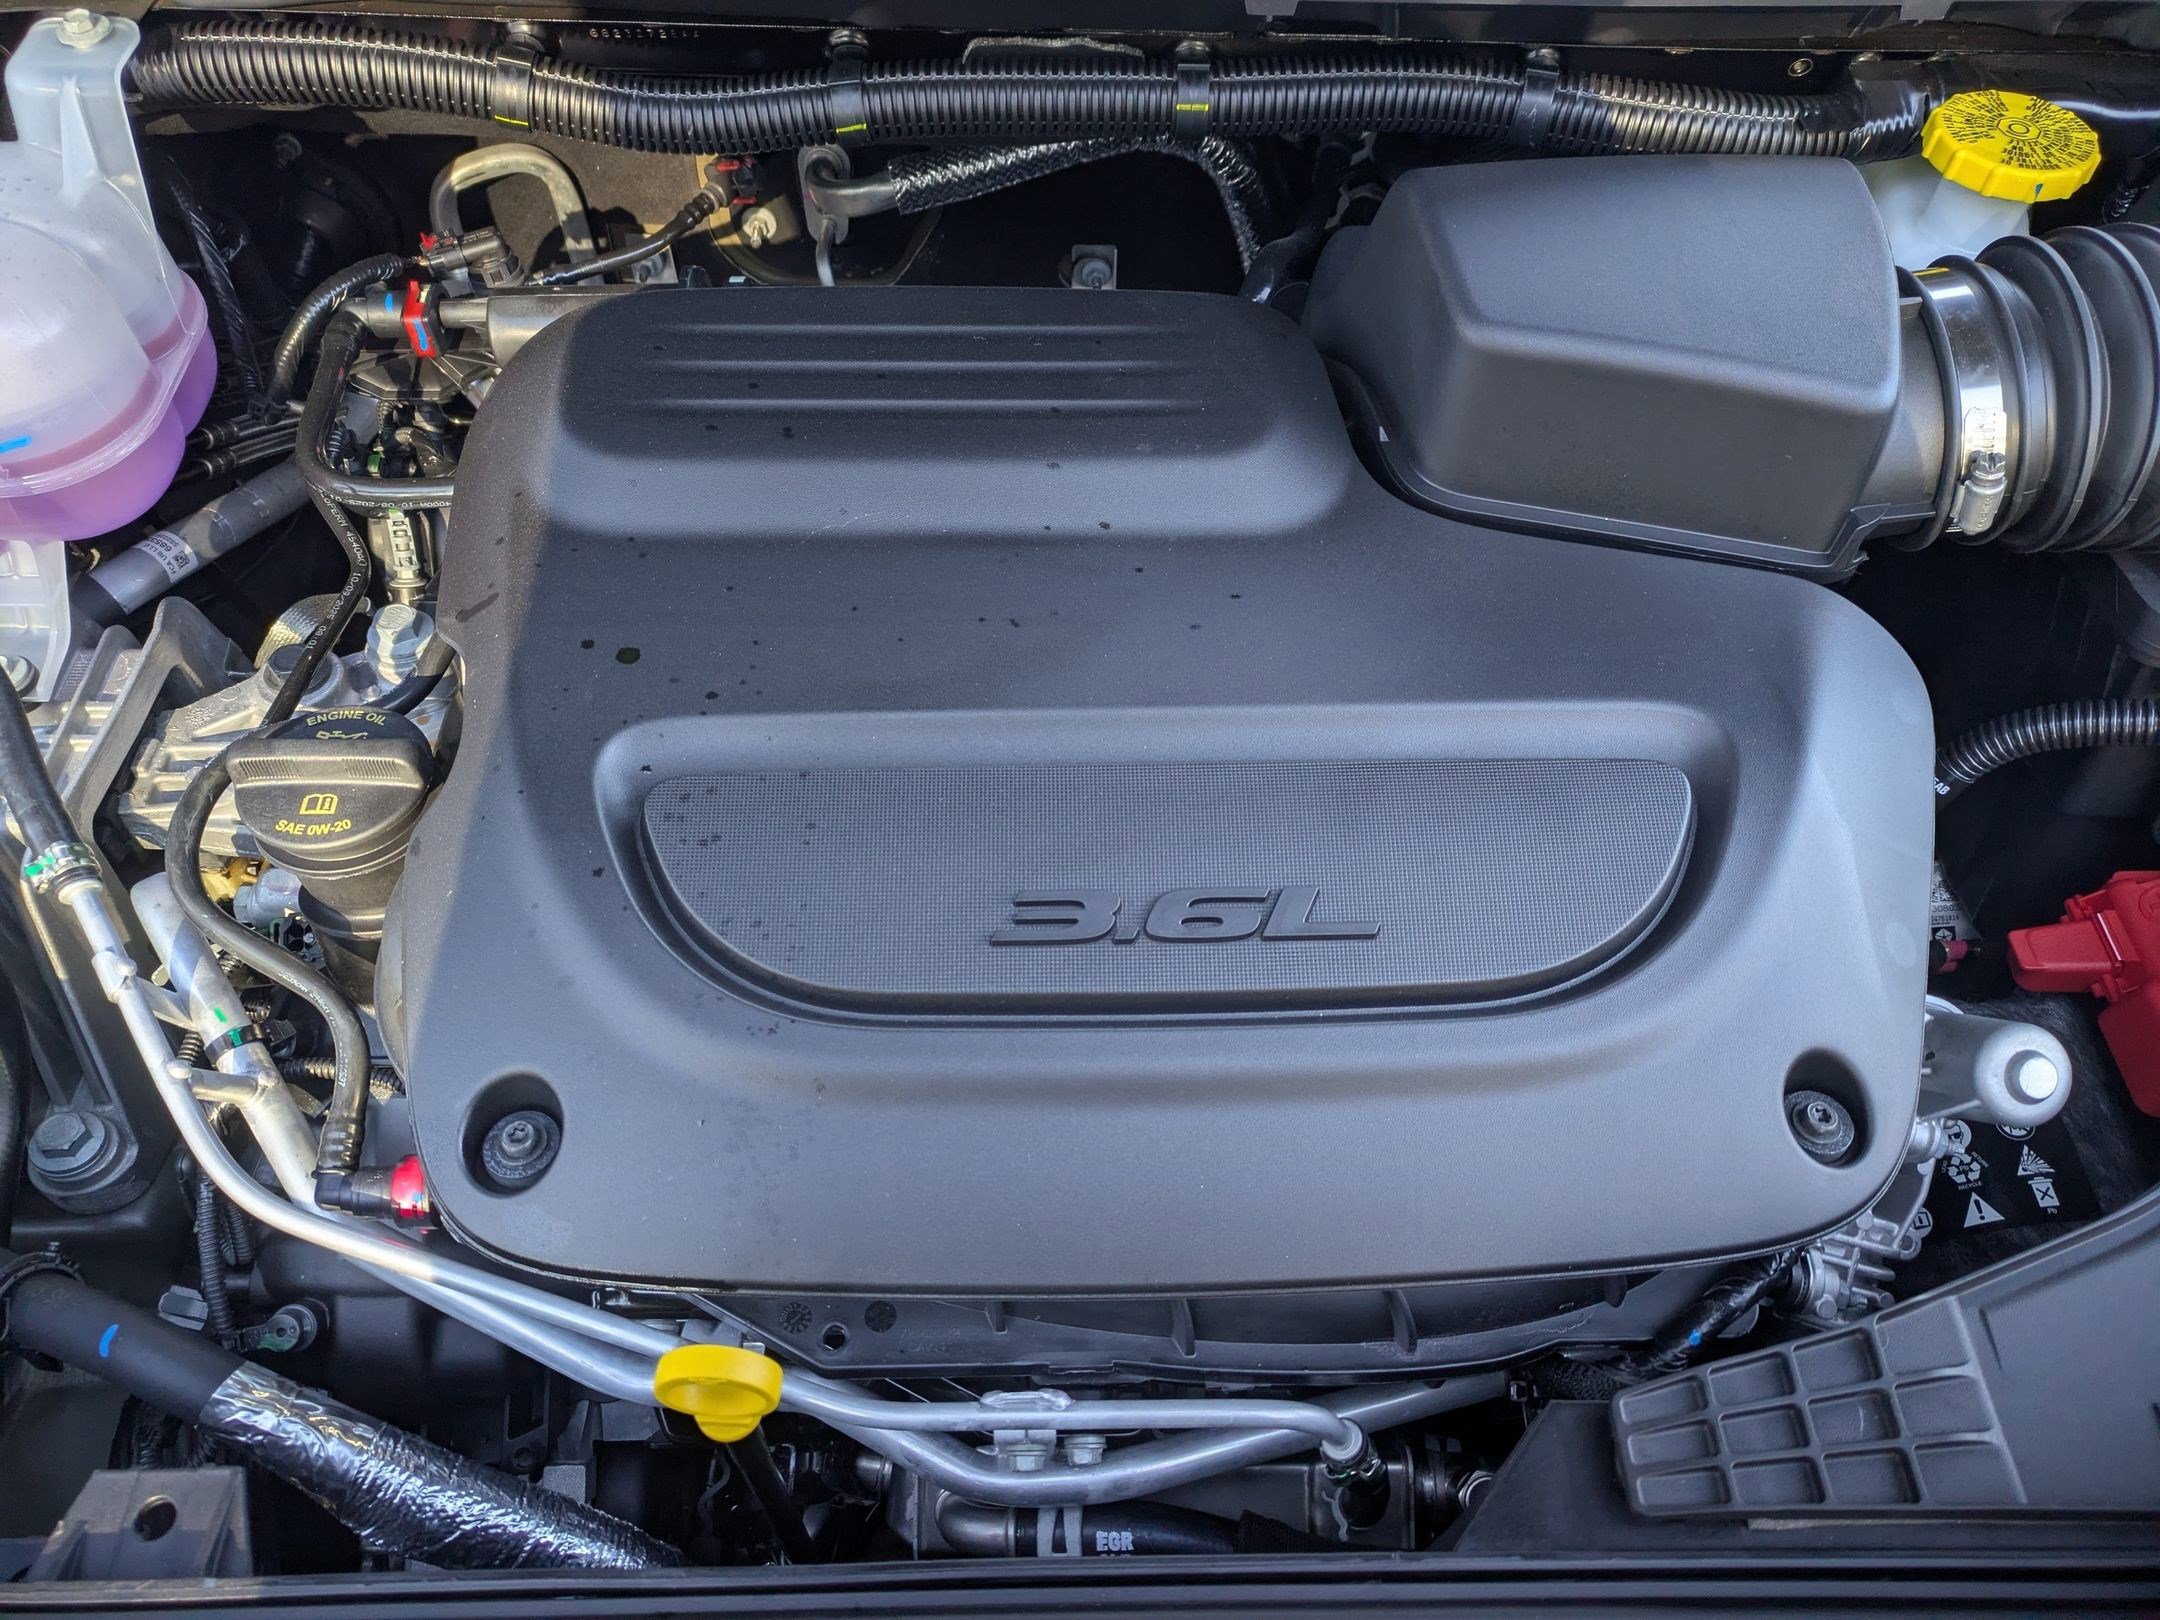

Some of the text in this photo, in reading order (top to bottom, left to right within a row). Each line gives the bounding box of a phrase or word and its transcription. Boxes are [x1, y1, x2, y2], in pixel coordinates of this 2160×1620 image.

[306, 710, 387, 727] ENGINE OIL
[275, 818, 352, 836] SAE 0W-20
[989, 885, 1381, 946] 3.6L
[2047, 1207, 2058, 1215] Pb
[1095, 1530, 1134, 1551] EGR
